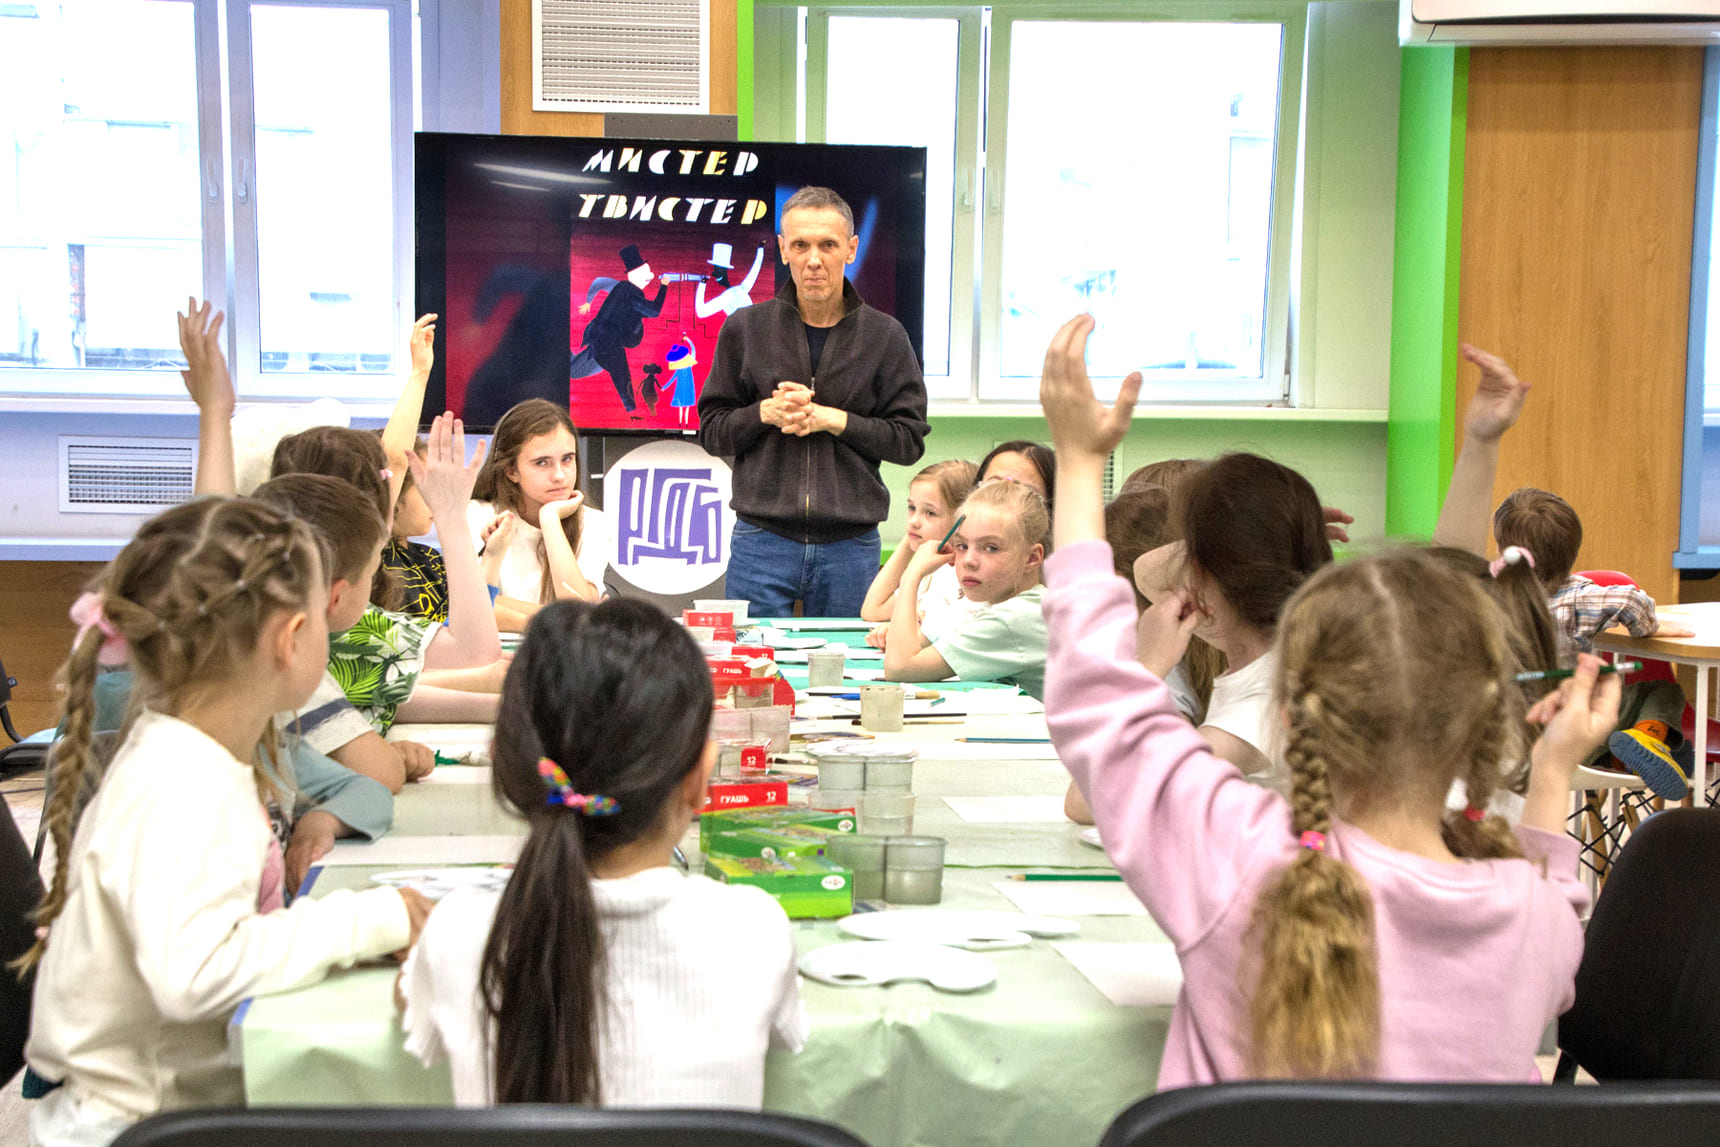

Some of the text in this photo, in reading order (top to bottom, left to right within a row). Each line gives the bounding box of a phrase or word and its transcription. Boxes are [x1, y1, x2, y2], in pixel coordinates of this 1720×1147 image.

[582, 148, 758, 176] МИСТЕР
[578, 194, 767, 224] ТВИСТЕР
[746, 756, 756, 764] 12
[720, 795, 749, 804] ГУАШЬ
[766, 791, 776, 800] 12
